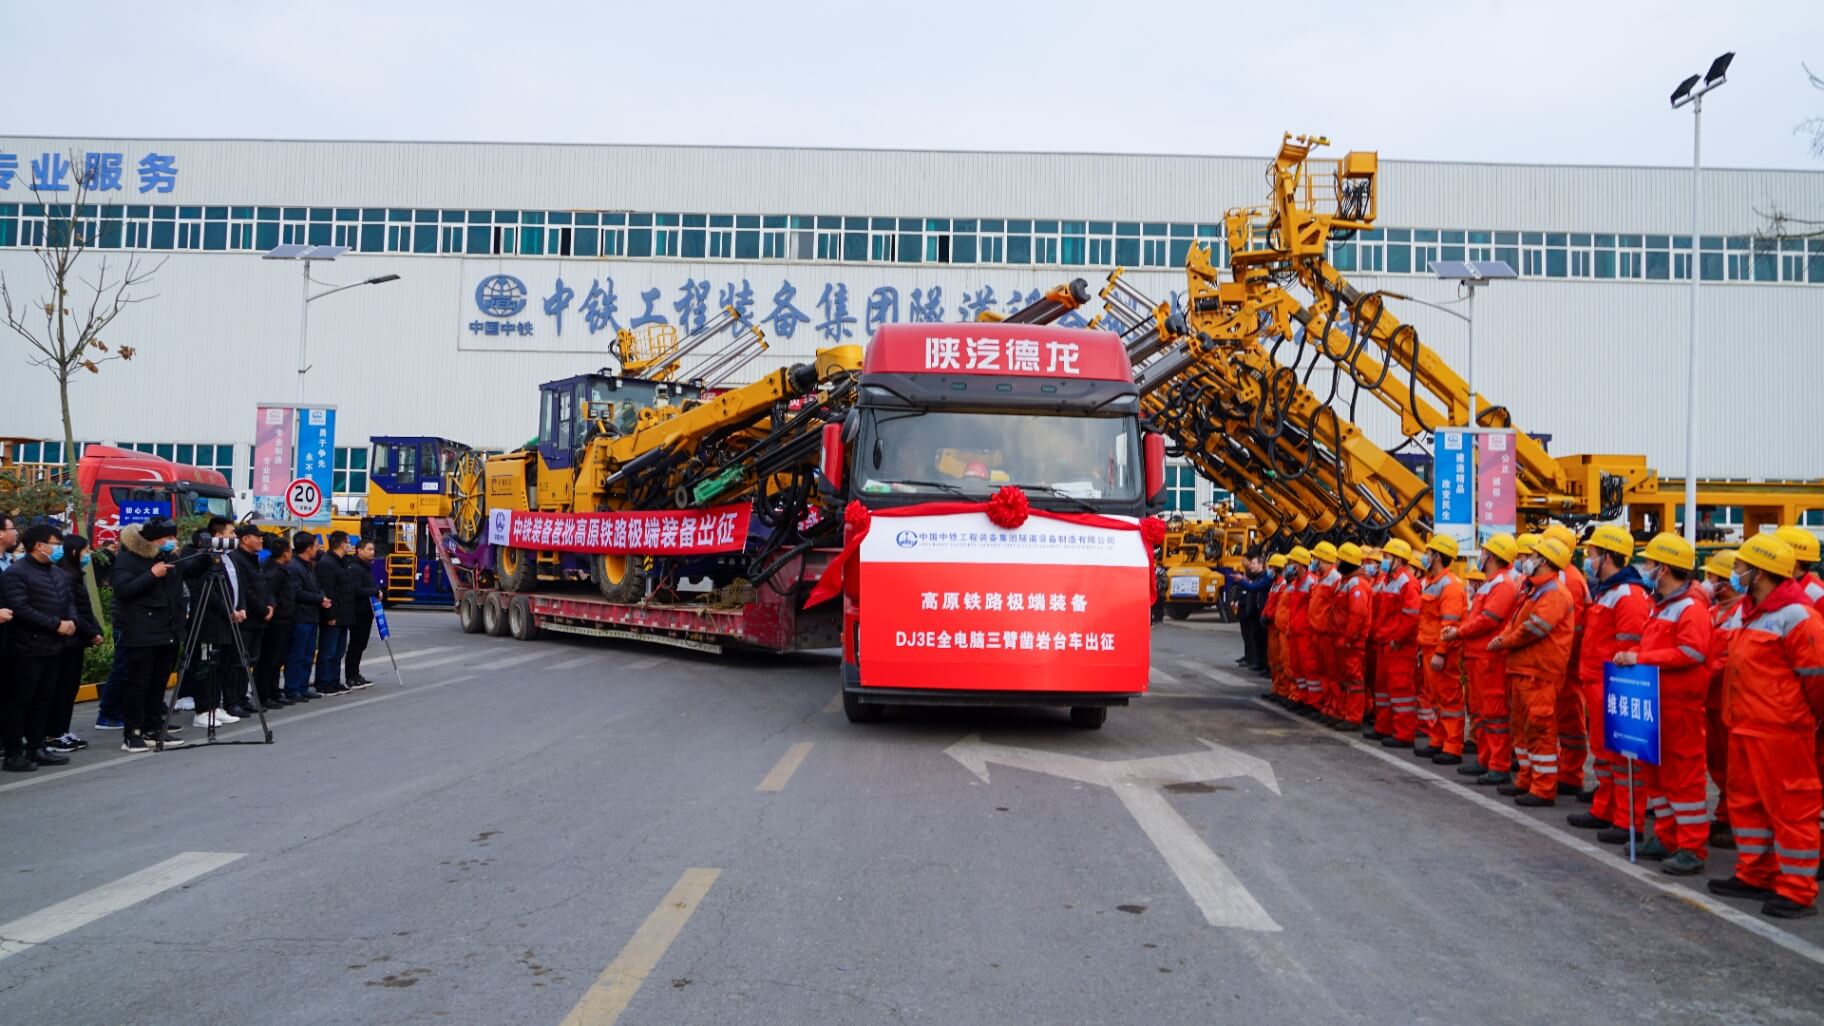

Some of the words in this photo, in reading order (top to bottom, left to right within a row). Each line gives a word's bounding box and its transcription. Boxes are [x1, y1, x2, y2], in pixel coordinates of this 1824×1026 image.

[469, 320, 534, 336] 中国中铁
[925, 336, 1079, 374] 陕汽德龙
[294, 485, 315, 502] 20
[513, 512, 738, 548] 中铁装备首批高原铁路极端装备出征
[921, 592, 1088, 612] 高原铁路极端装备
[895, 630, 1116, 651] DJ3E全电脑三臂凿岩台车出征
[1607, 692, 1655, 723] 维保团队
